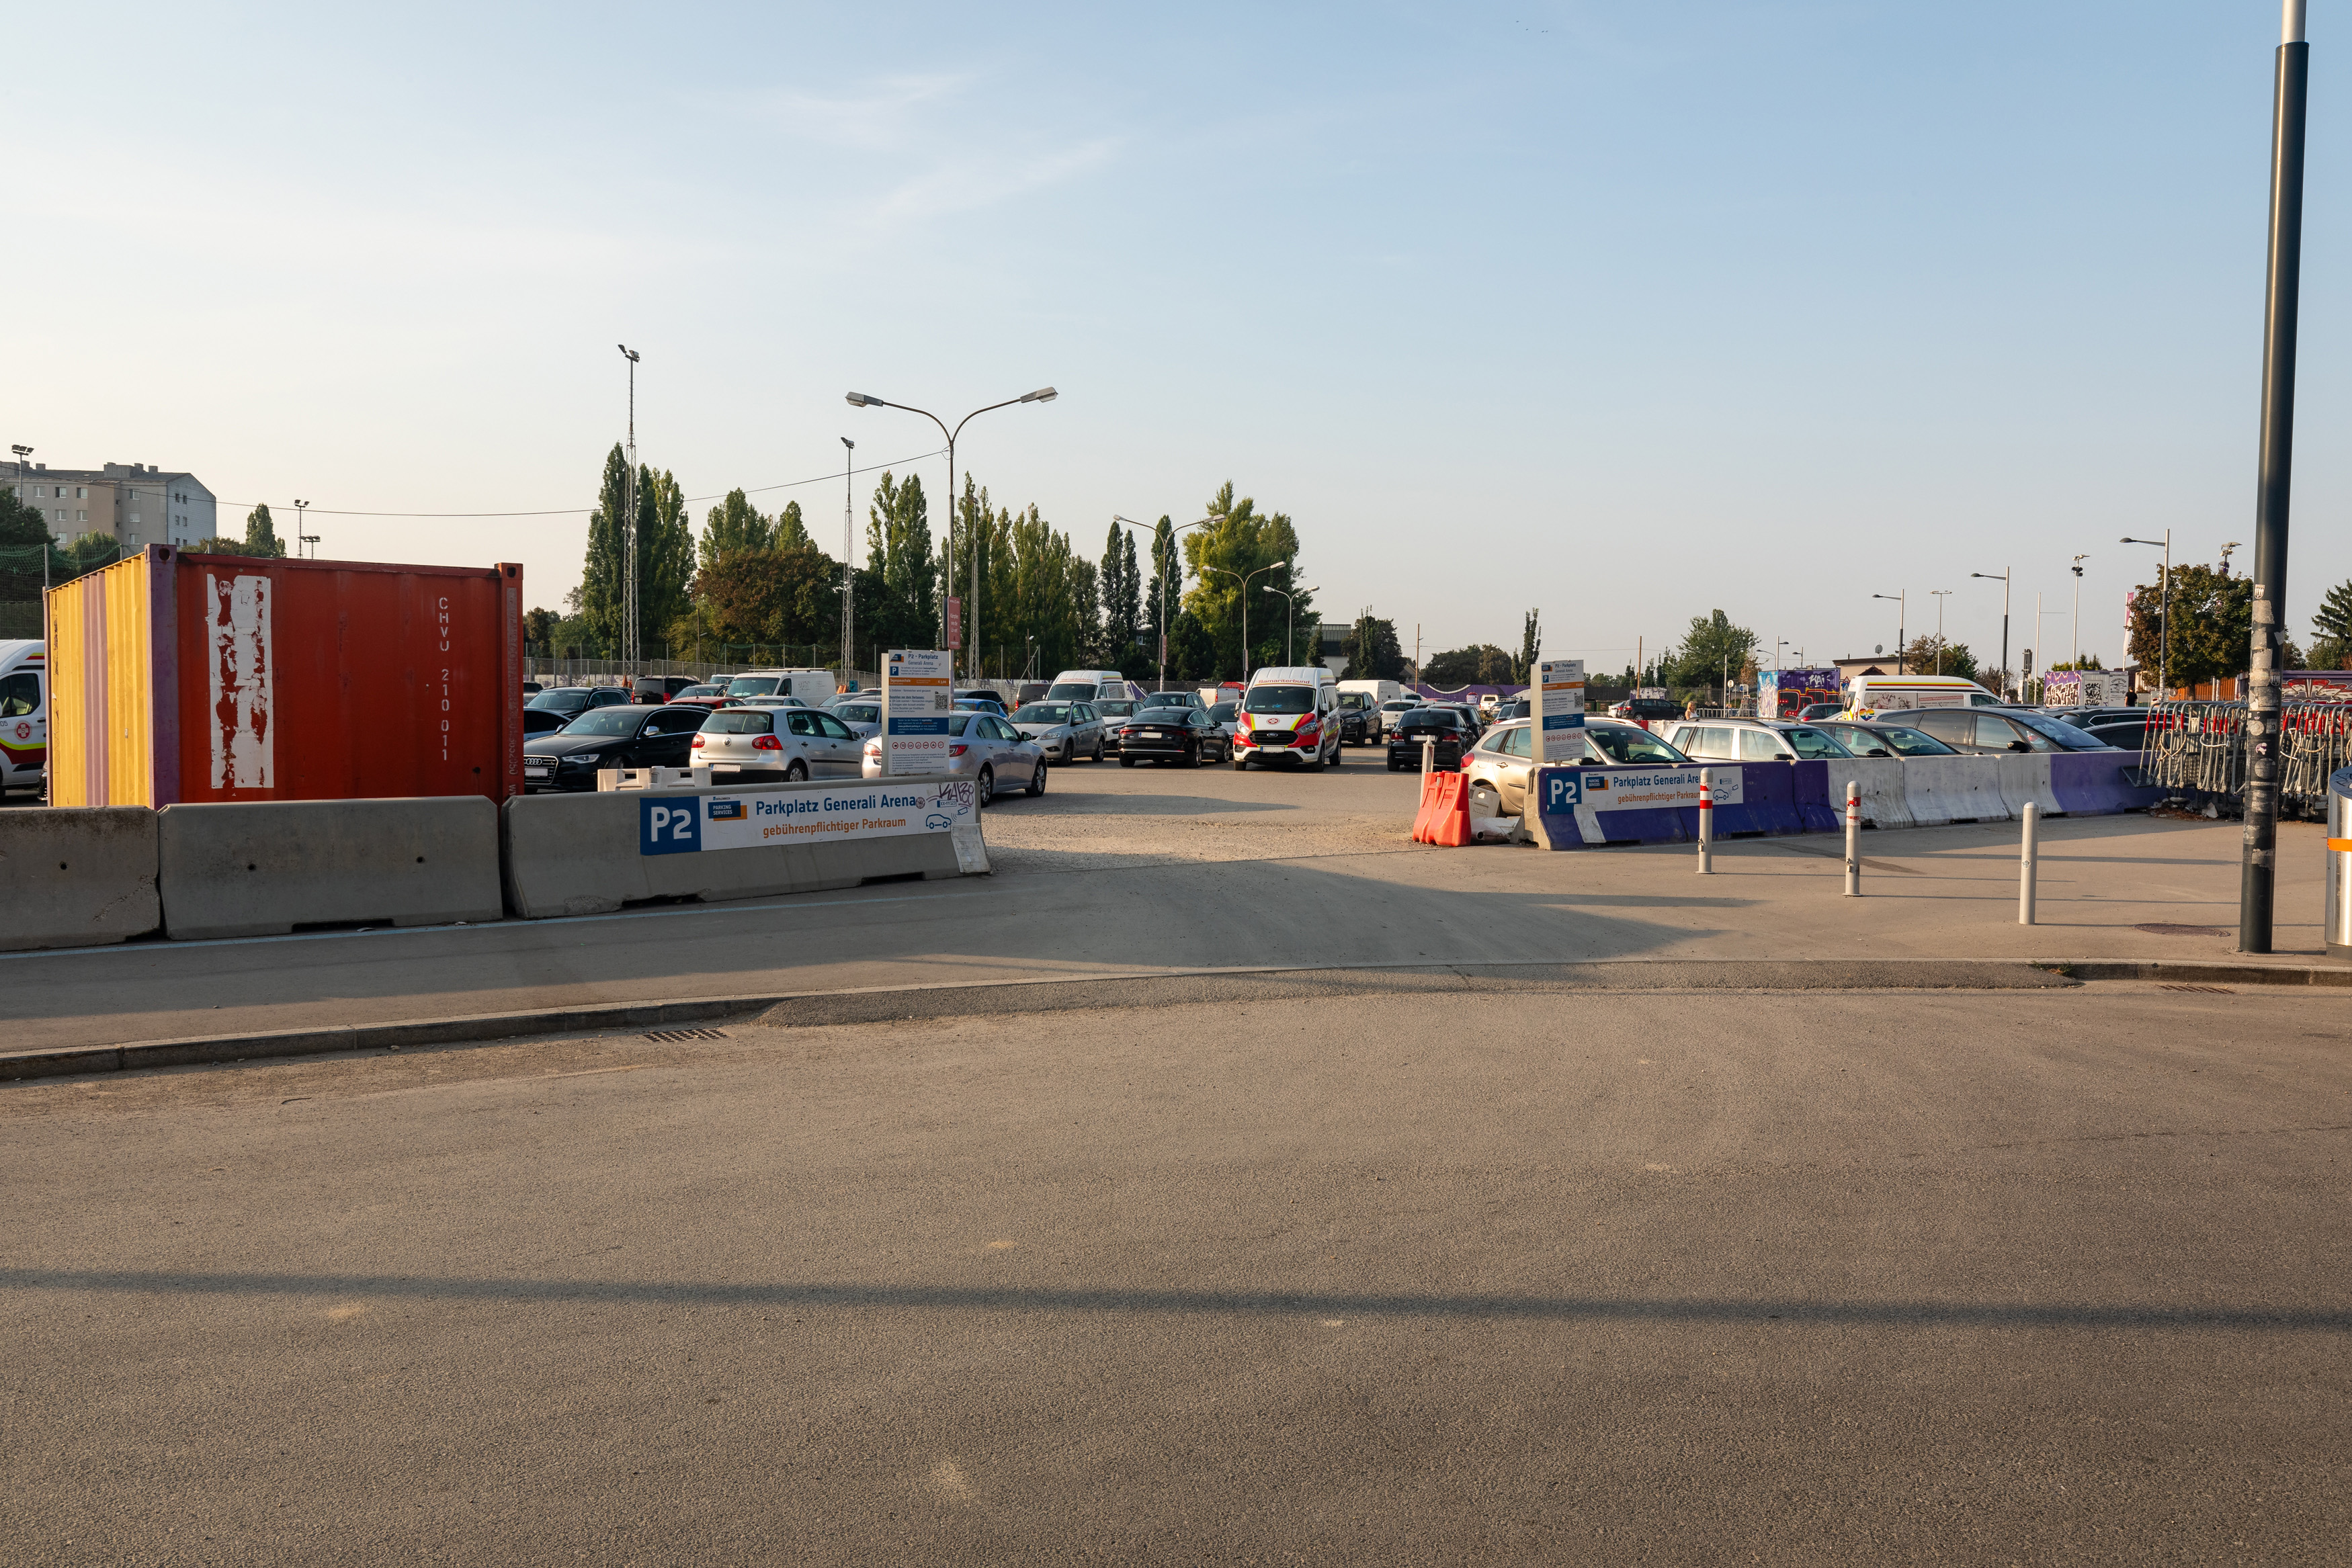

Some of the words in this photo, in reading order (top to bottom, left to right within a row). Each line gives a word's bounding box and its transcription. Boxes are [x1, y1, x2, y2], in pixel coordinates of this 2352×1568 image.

[439, 597, 449, 651] CHVU
[1551, 779, 1577, 804] P2
[1613, 776, 1651, 789] Parkplatz
[1654, 774, 1685, 785] Generali
[1687, 774, 1701, 784] Are
[756, 799, 818, 817] Parkplatz
[824, 795, 876, 812] Generali
[881, 794, 916, 808] Arena
[1618, 792, 1675, 805] gebührenpflichtiger
[651, 807, 691, 842] P2
[763, 820, 859, 838] gebührenpflichtiger
[862, 818, 906, 829] Parkraum
